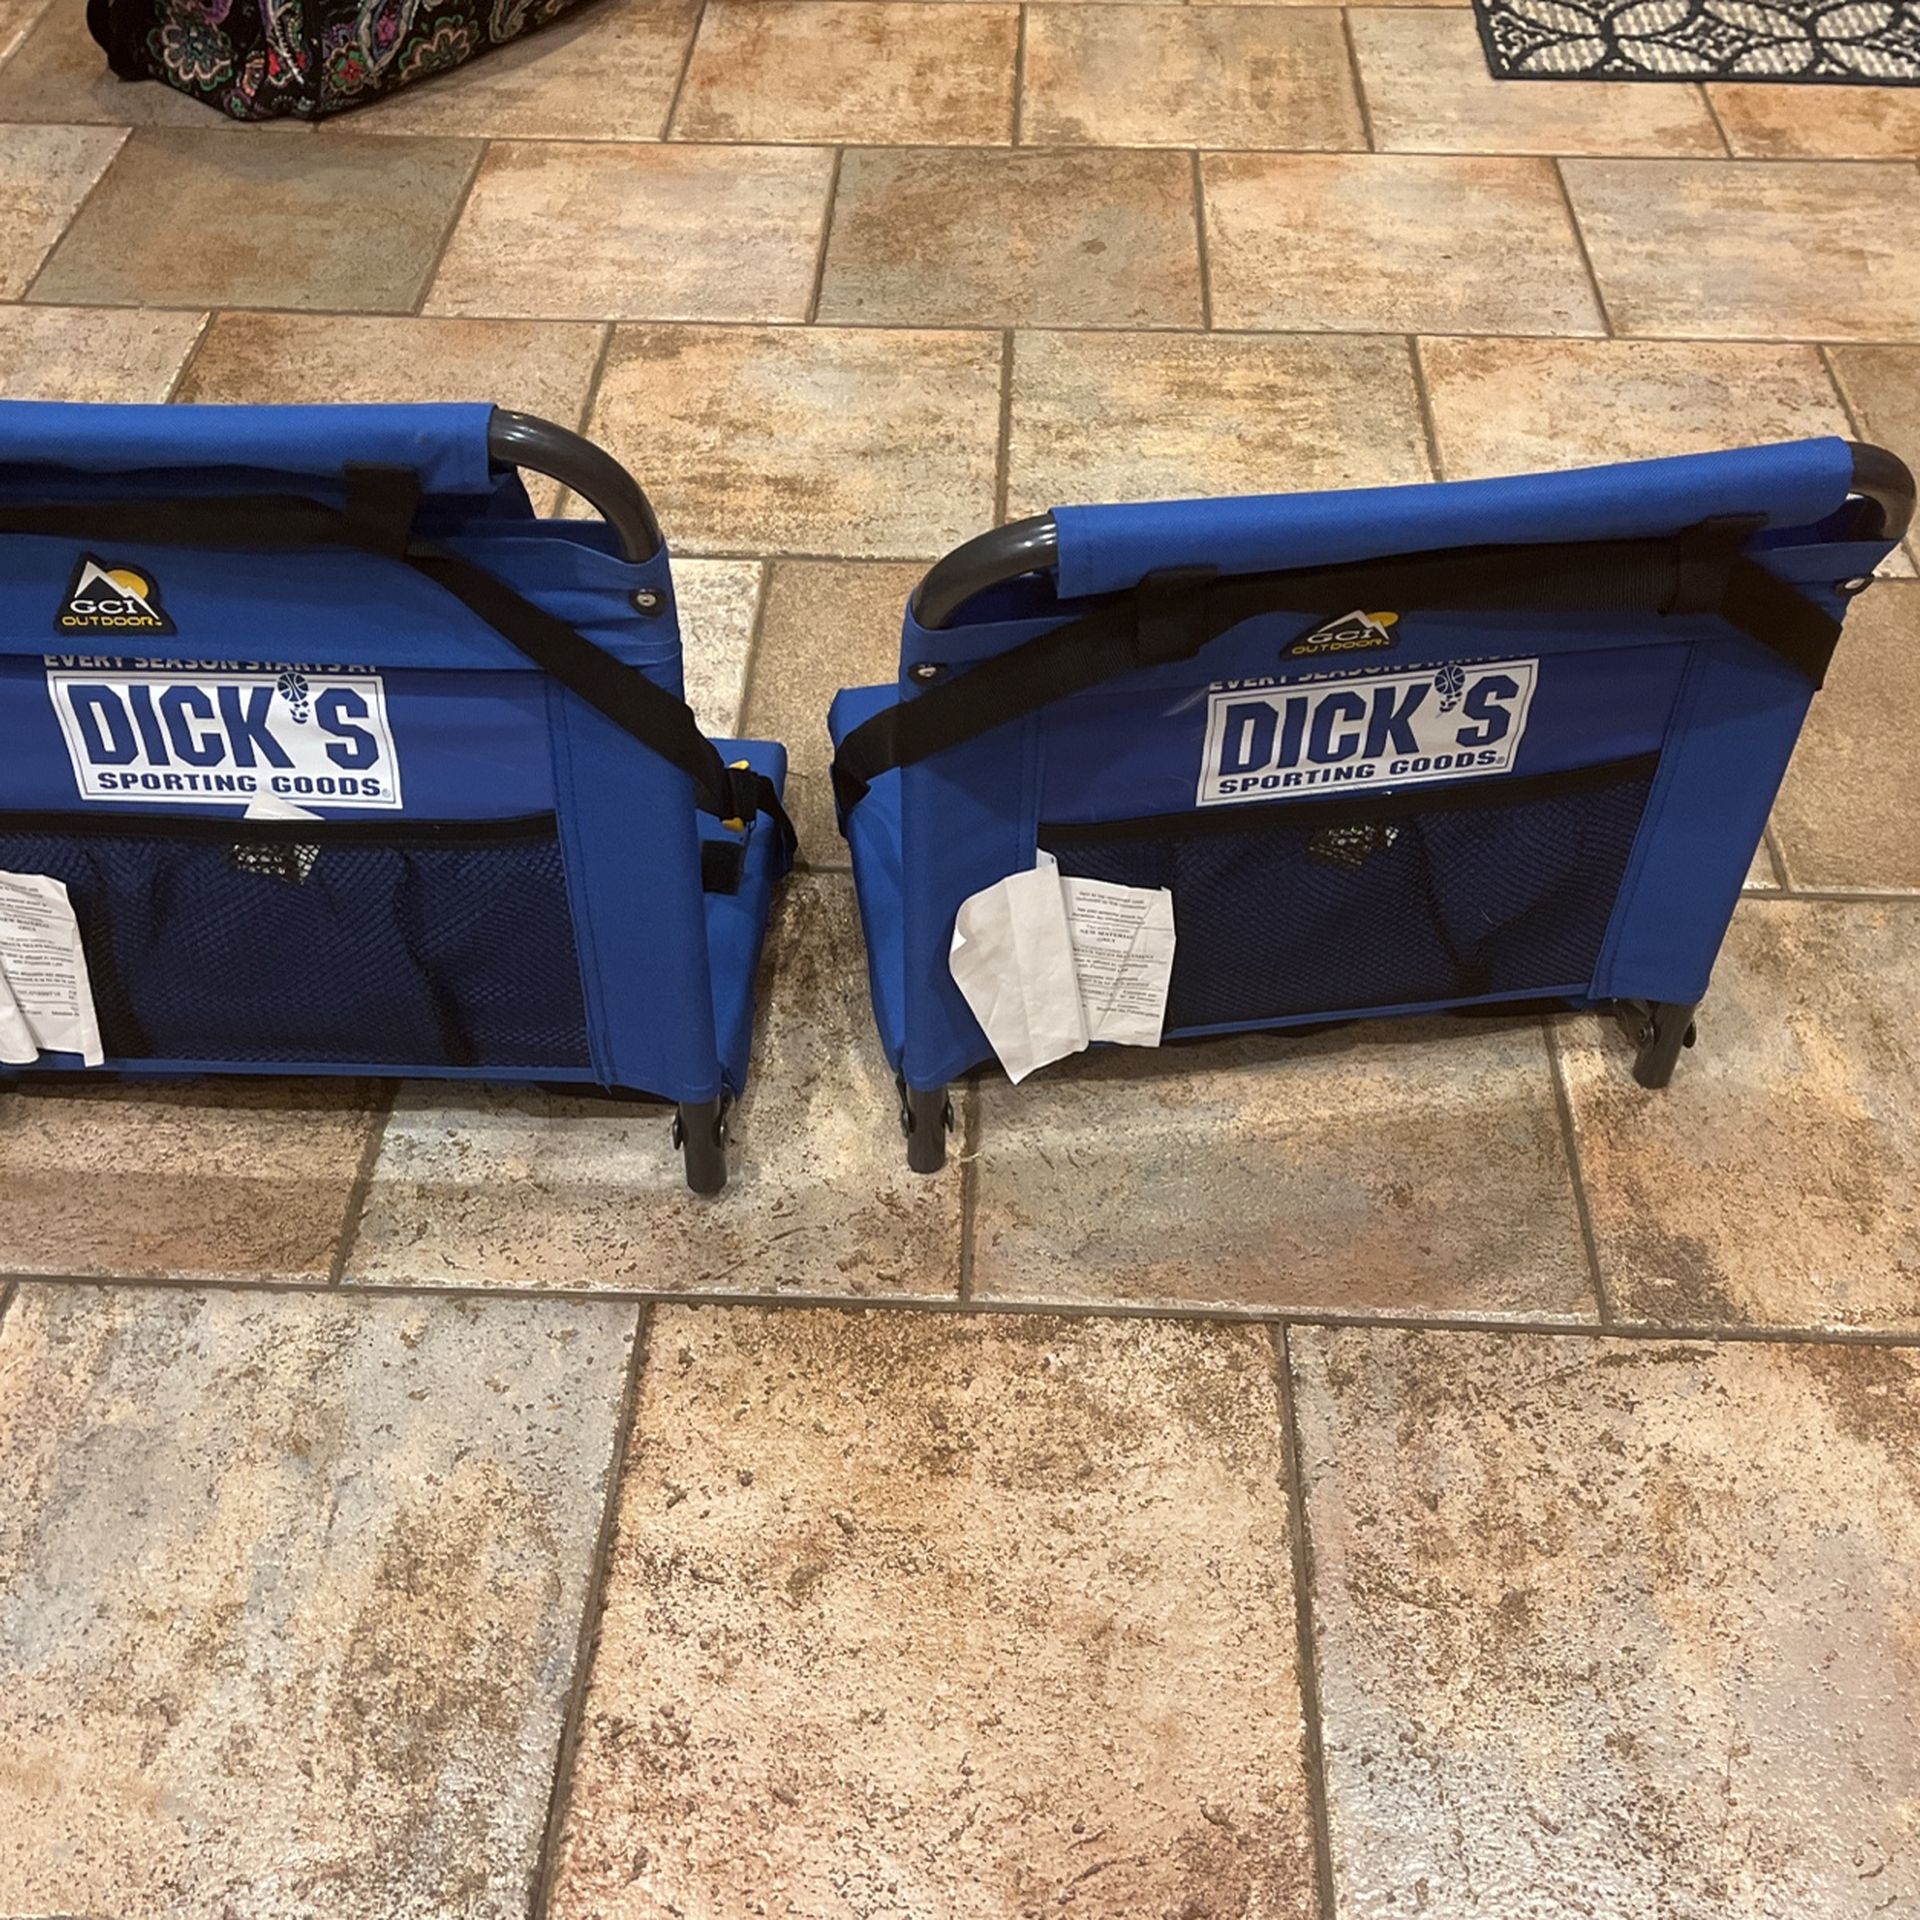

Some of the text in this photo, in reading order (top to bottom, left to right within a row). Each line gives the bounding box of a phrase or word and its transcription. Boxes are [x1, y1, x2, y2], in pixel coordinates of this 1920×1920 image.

[70, 600, 138, 614] GCI
[62, 615, 154, 626] OUTDOOR
[1307, 628, 1375, 644] GCI
[1291, 638, 1382, 655] OUTDOOR
[67, 672, 380, 770] DICK'S
[1219, 664, 1520, 776] DICK'S
[98, 773, 257, 793] SPORTING
[1219, 764, 1376, 794] SPORTING
